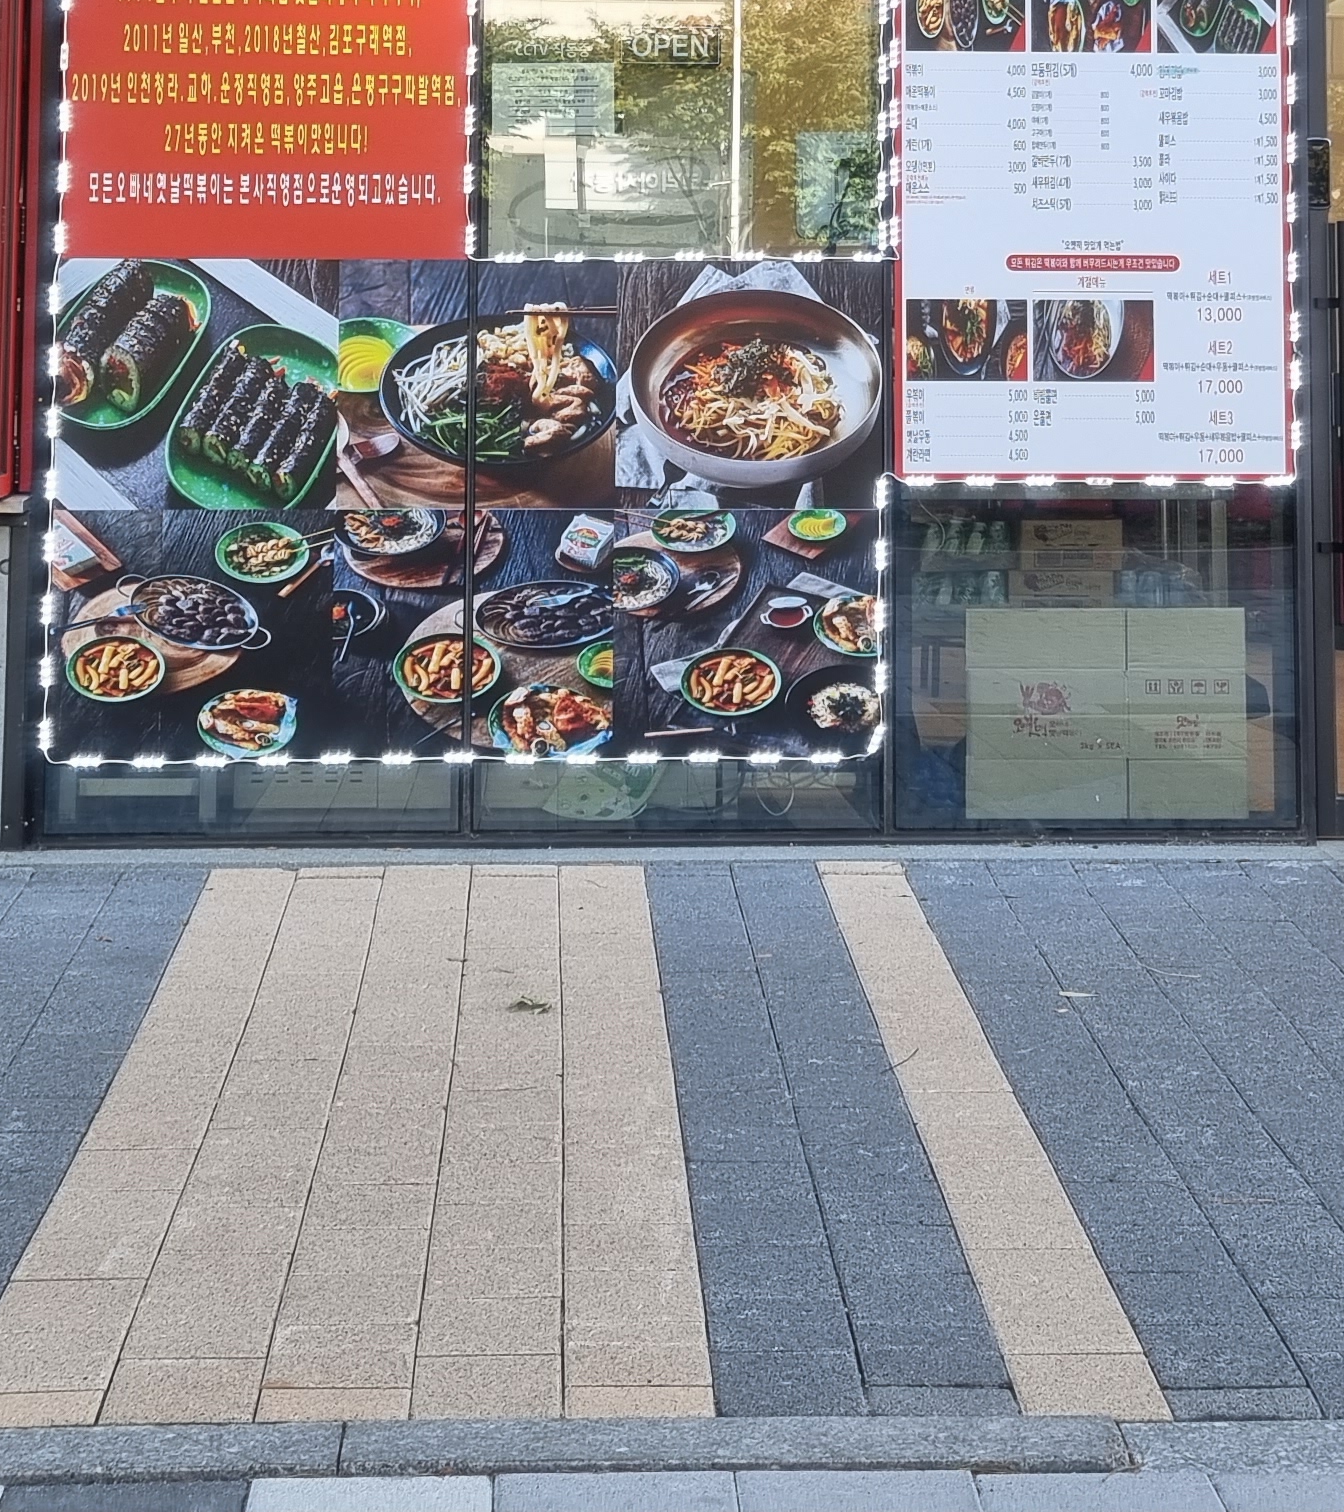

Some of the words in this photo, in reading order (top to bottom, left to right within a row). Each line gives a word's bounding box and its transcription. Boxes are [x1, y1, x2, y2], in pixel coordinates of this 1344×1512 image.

[124, 24, 172, 54] 2011년
[633, 35, 709, 57] OPEN
[1130, 64, 1152, 78] 4,000
[72, 73, 121, 103] 2019년
[164, 122, 222, 155] 27년동안
[228, 123, 264, 155] 지켜온
[1208, 271, 1231, 285] 세트1
[1197, 308, 1242, 323] 13,000
[1208, 341, 1232, 356] 세트2
[1198, 380, 1243, 395] 17,000
[1209, 410, 1233, 425] 세트3
[1199, 449, 1244, 464] 17,000
